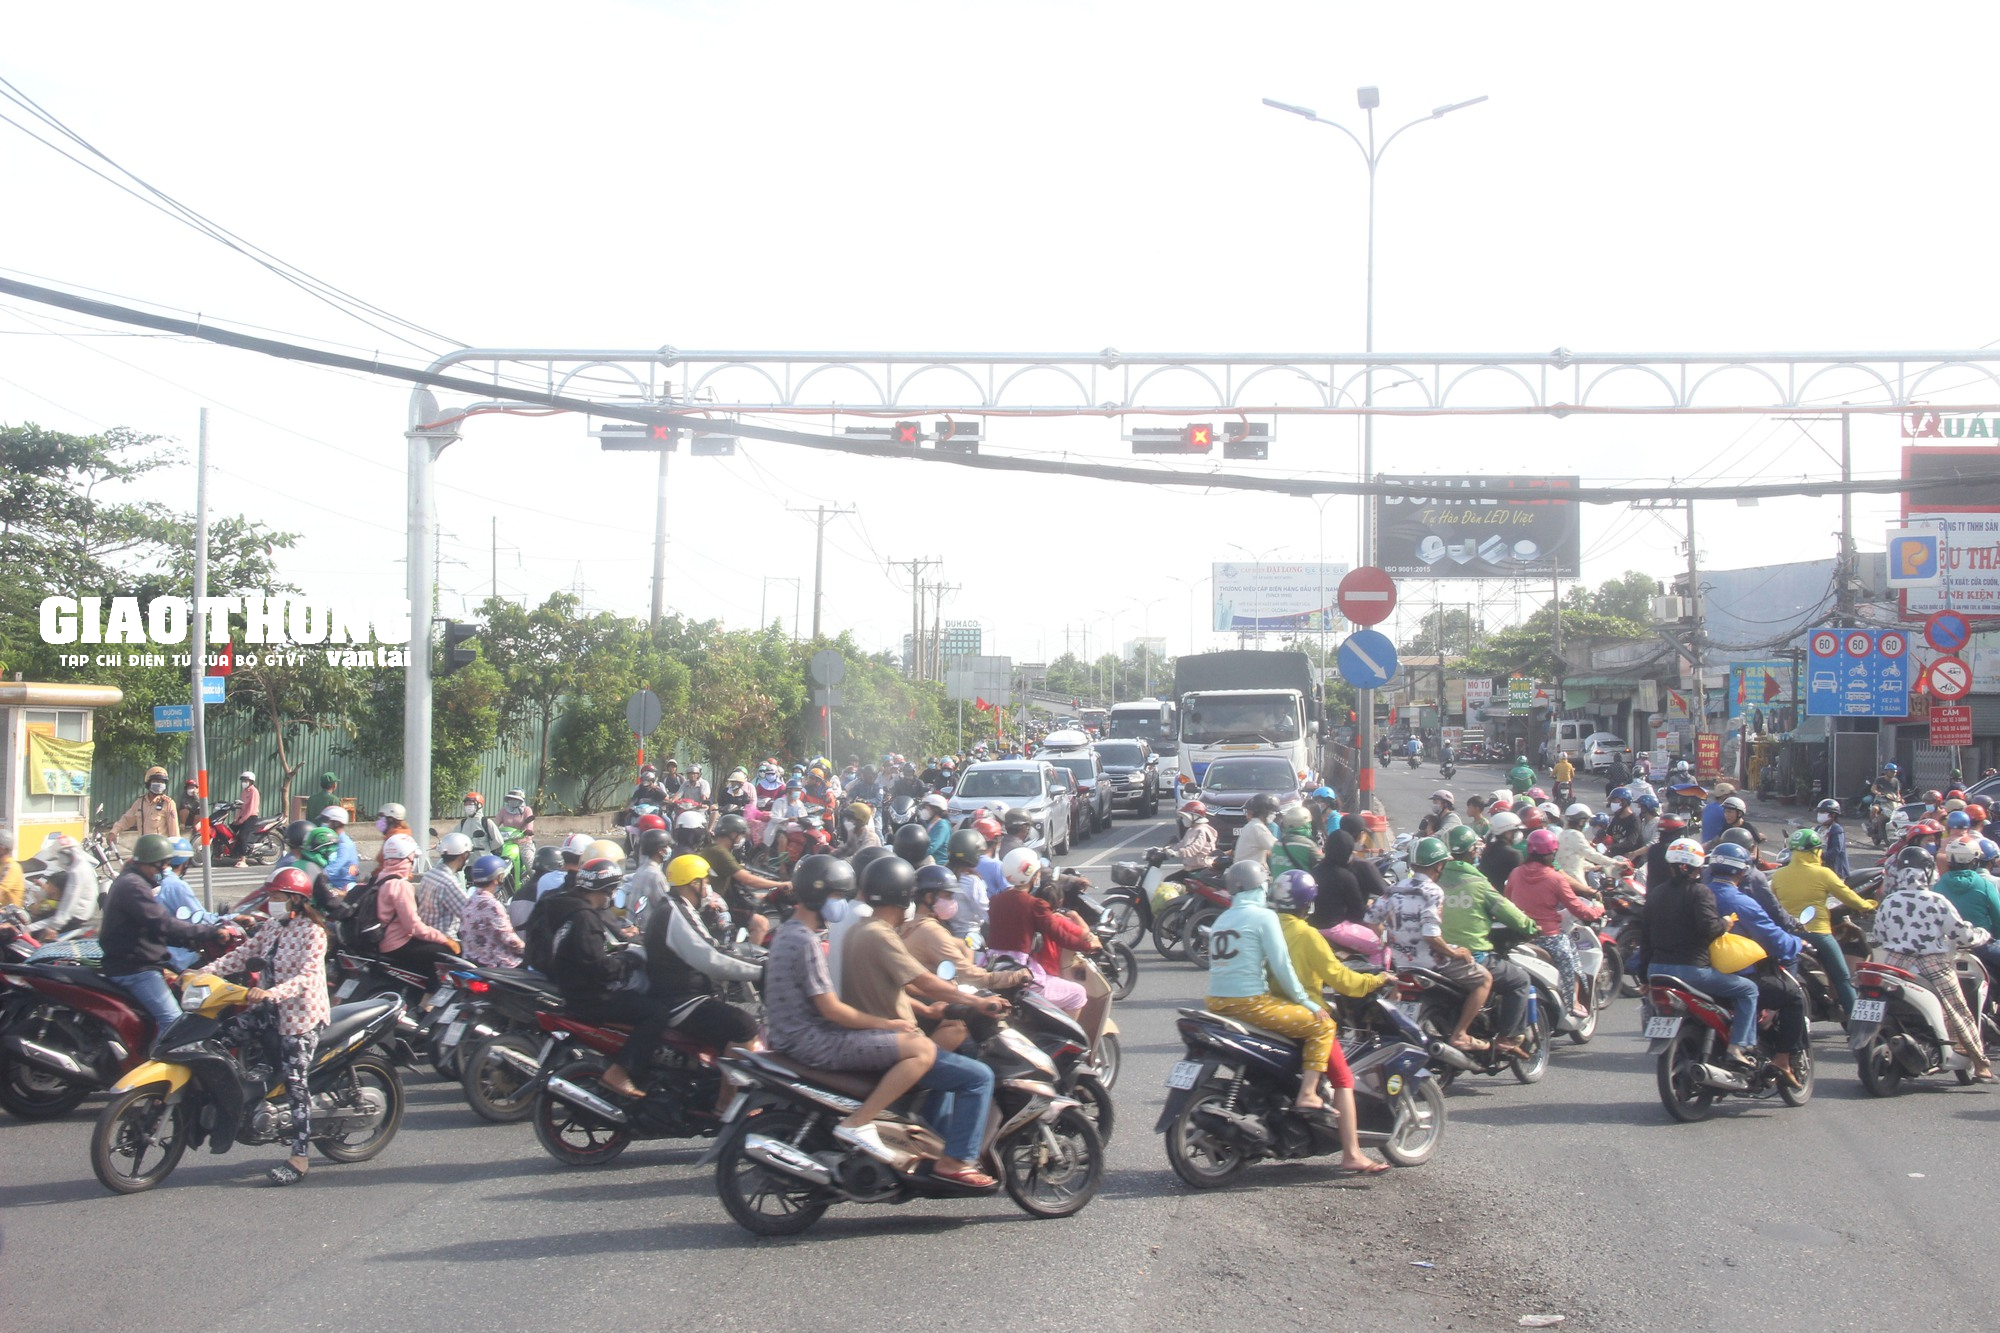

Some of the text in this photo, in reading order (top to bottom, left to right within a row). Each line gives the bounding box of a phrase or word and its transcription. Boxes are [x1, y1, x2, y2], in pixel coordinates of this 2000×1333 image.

[1438, 509, 1458, 523] Hào
[1461, 510, 1481, 524] Đèn
[1484, 510, 1510, 524] LED
[1512, 509, 1535, 526] Việt
[1958, 522, 1965, 531] TY
[1967, 522, 1983, 531] TNHH
[1942, 577, 1953, 585] SN
[1967, 588, 1993, 601] KIỆN
[1819, 639, 1830, 650] 60
[1852, 639, 1863, 650] 60
[1886, 640, 1897, 651] 60
